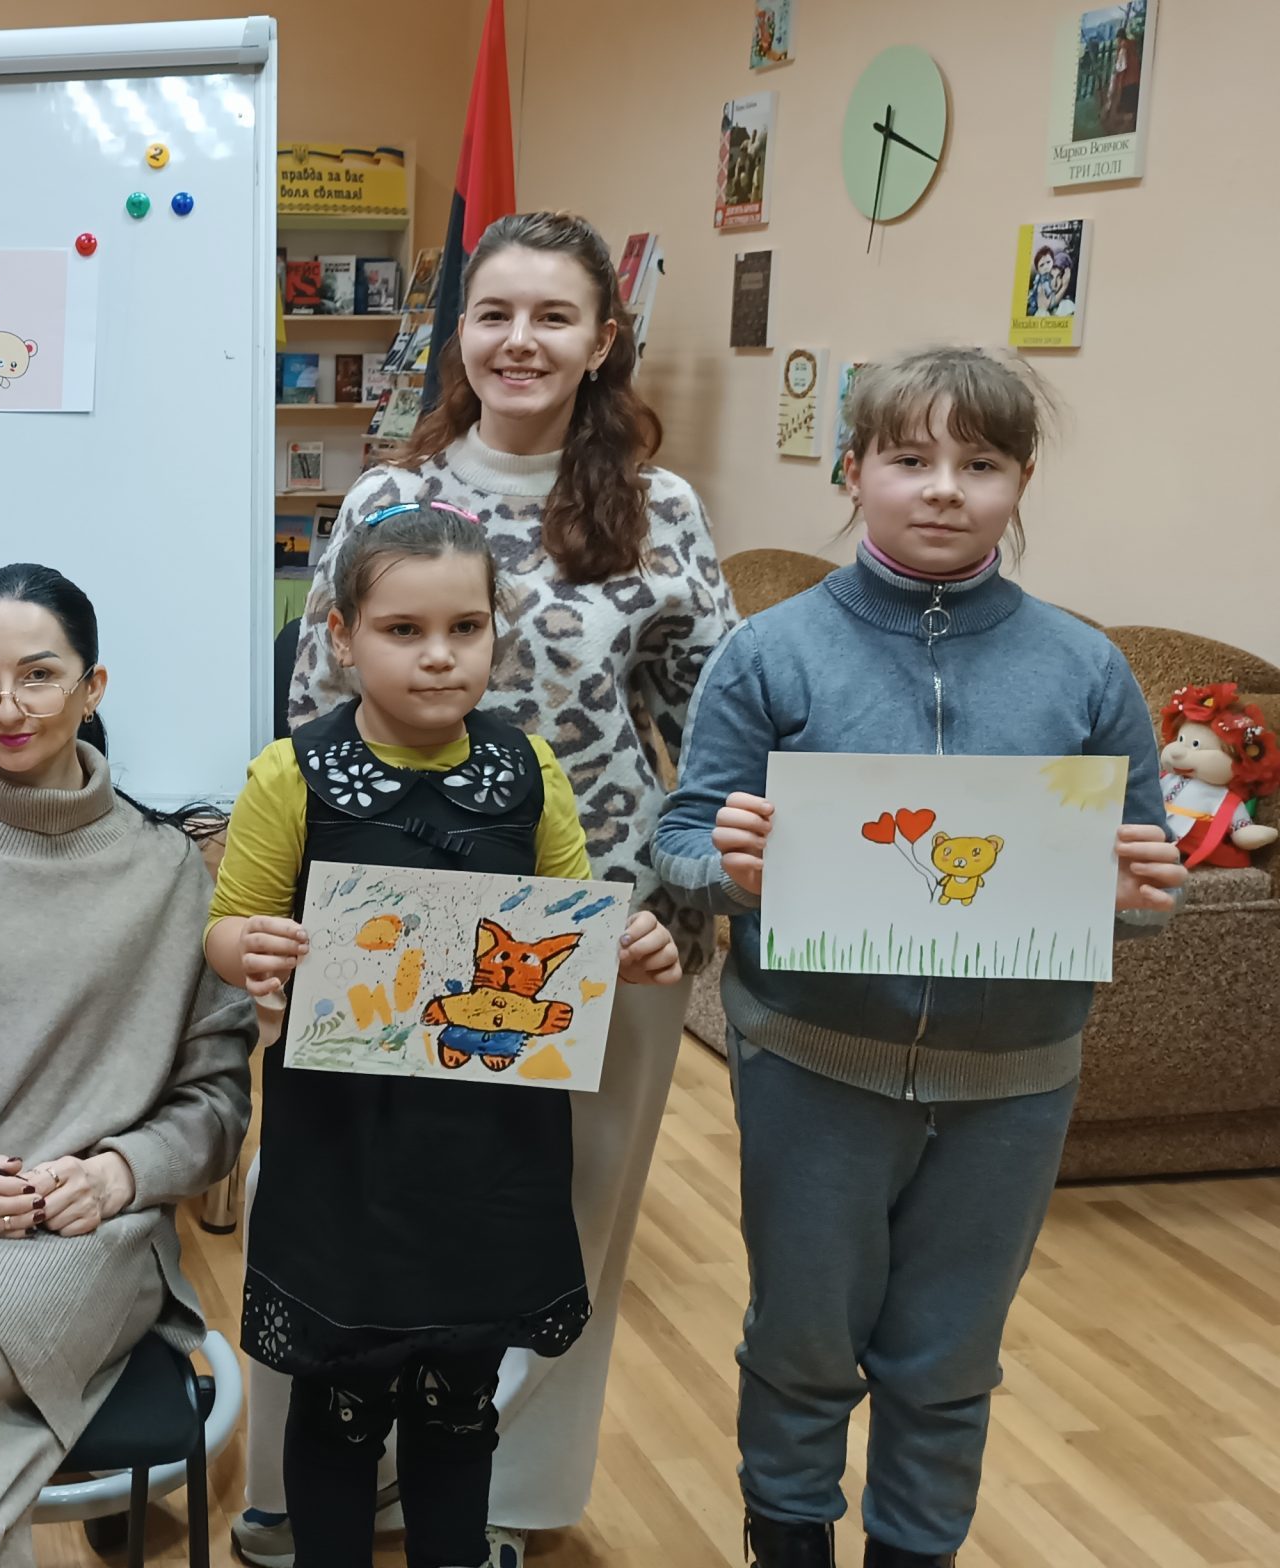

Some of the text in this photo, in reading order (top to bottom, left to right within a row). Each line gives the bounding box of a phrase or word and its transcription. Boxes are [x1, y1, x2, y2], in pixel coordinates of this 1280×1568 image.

[150, 147, 163, 161] 2
[1053, 146, 1087, 162] Марко
[327, 171, 341, 182] за
[345, 169, 364, 183] вас
[1070, 160, 1121, 180] ТРИ ДОЛІ
[280, 186, 309, 198] воля
